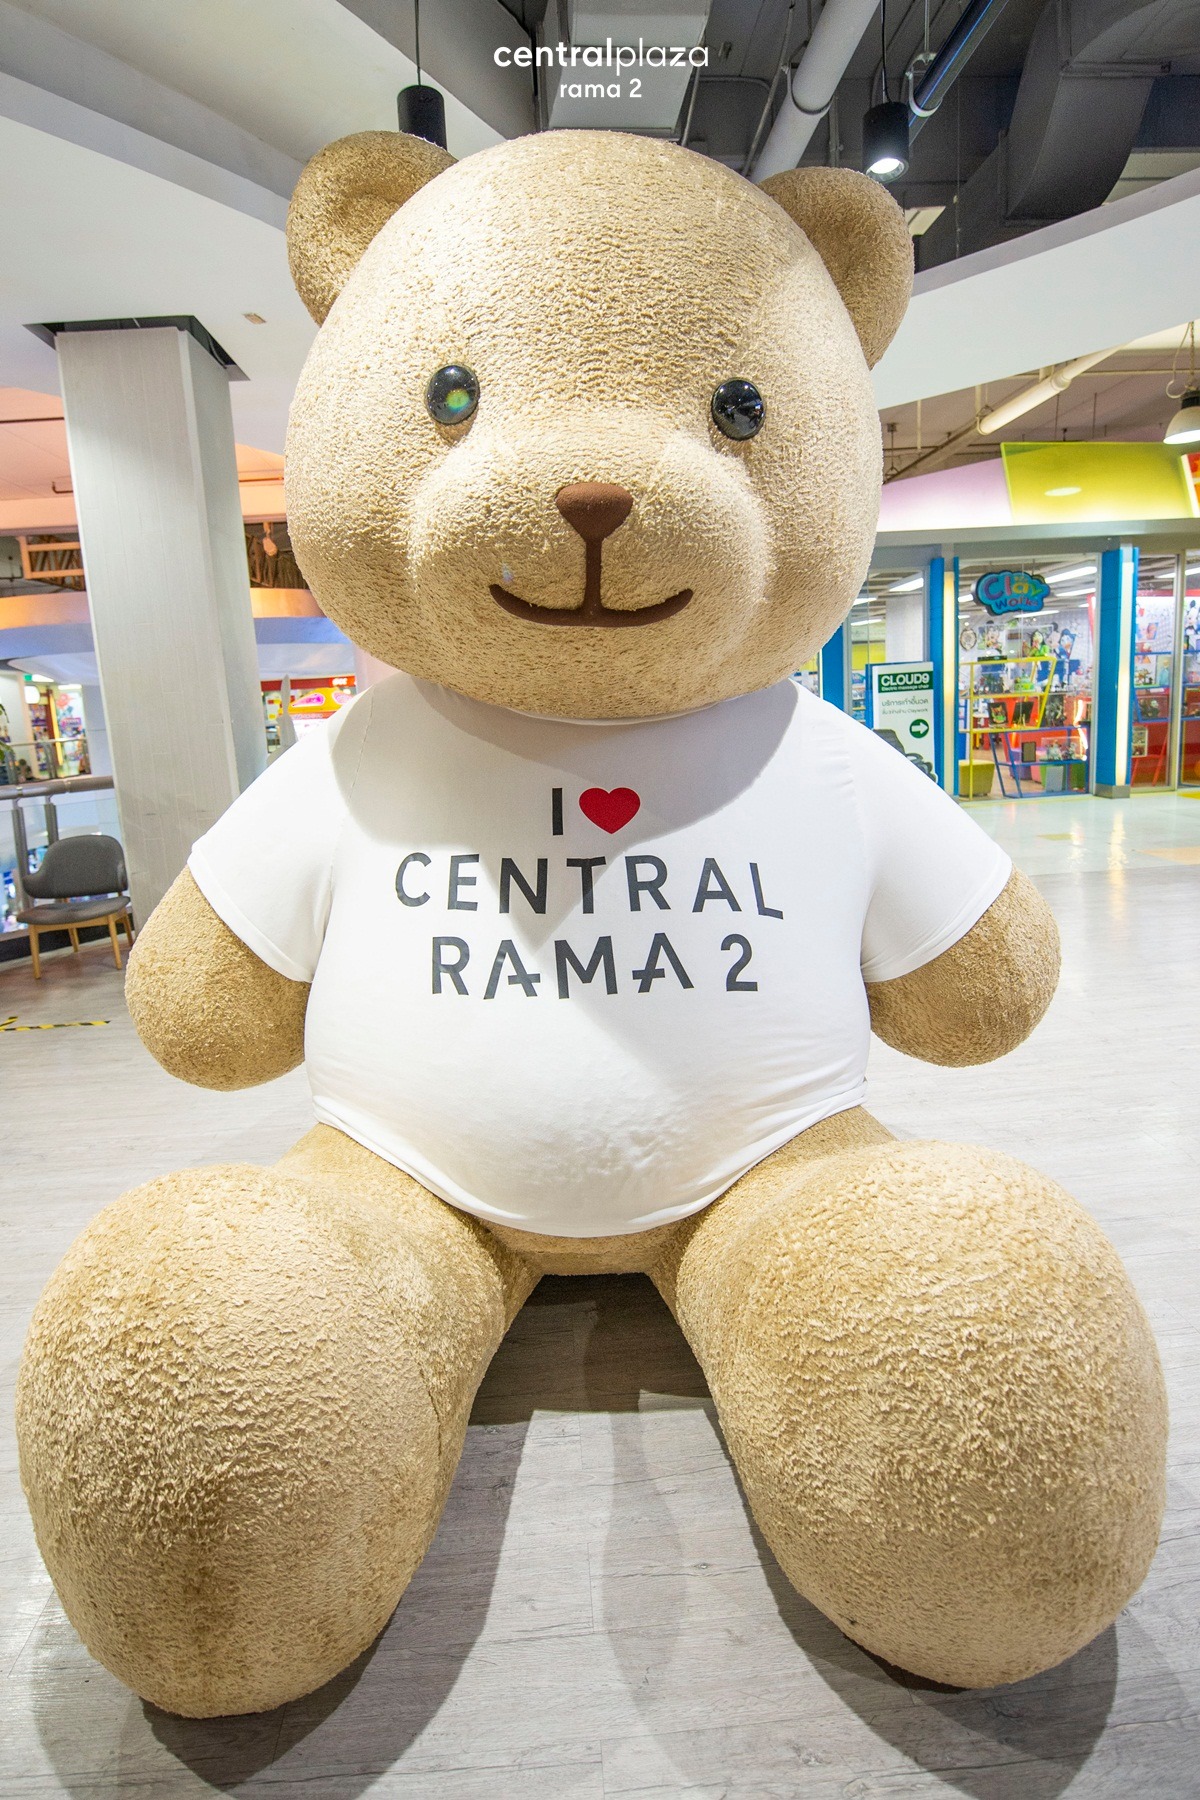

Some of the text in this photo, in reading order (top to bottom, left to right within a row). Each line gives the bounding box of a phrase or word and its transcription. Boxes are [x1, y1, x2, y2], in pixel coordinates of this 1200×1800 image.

[983, 575, 1043, 600] Clay
[881, 673, 930, 687] CLOUD9
[552, 787, 564, 836] I
[395, 852, 784, 919] CENTRAL
[432, 932, 758, 1000] RAMA 2
